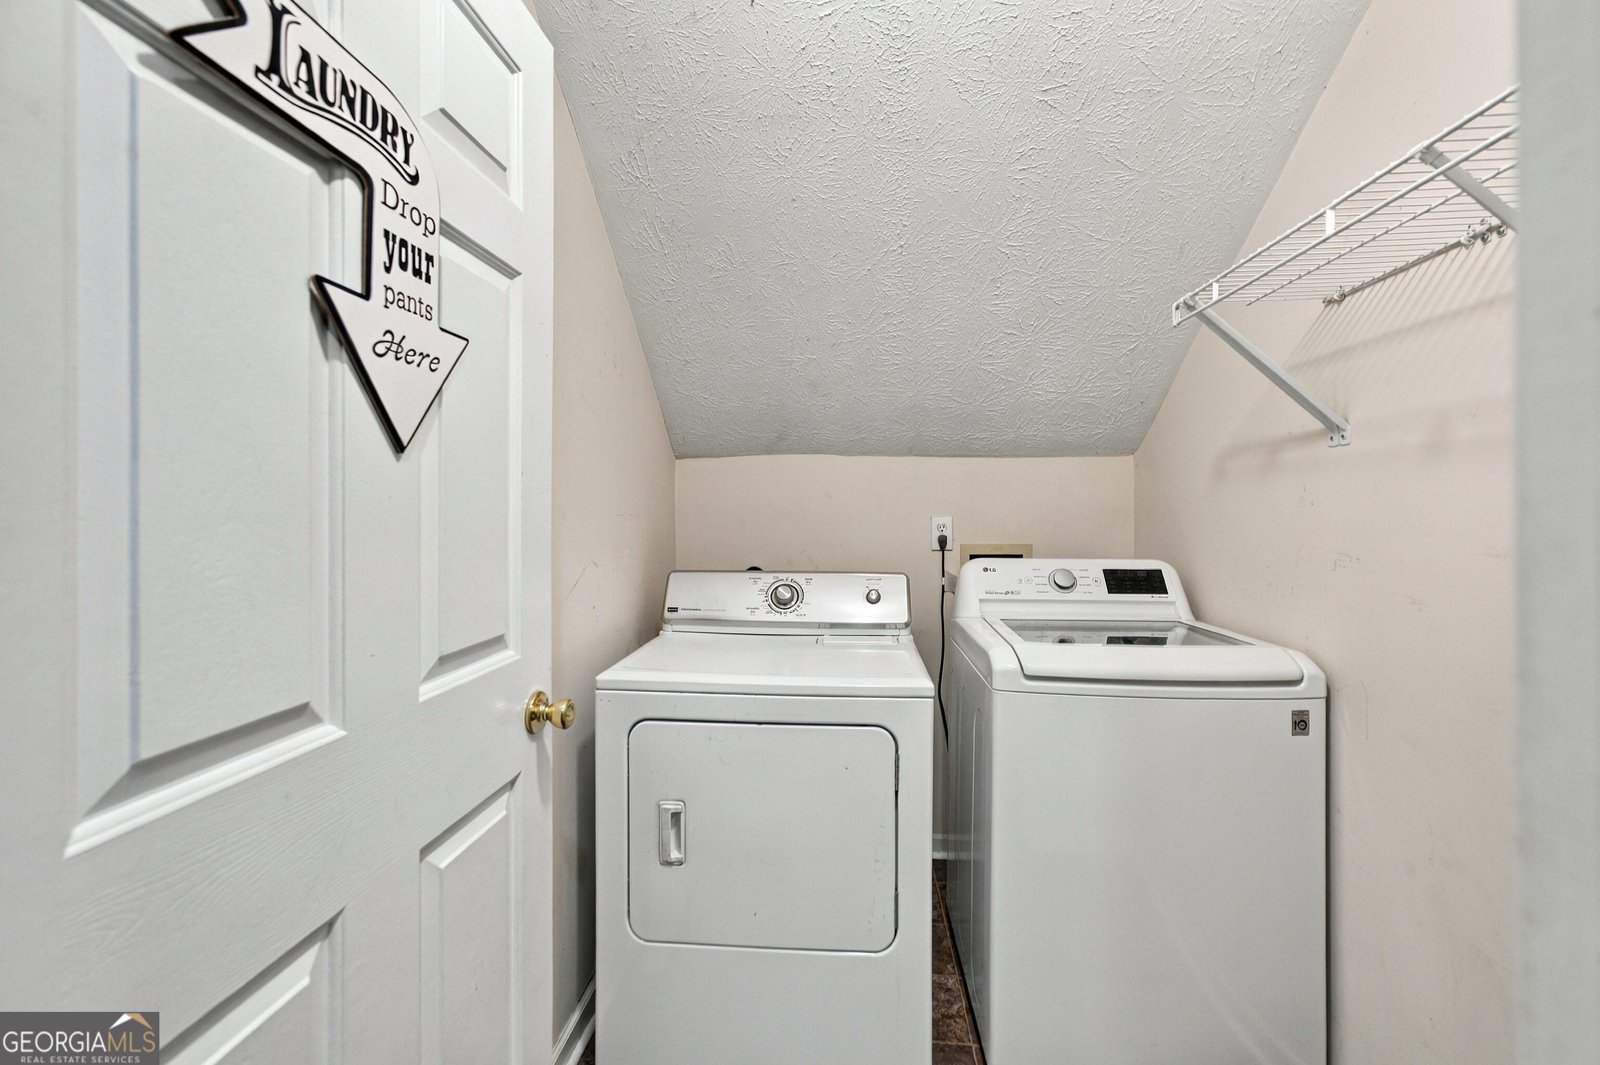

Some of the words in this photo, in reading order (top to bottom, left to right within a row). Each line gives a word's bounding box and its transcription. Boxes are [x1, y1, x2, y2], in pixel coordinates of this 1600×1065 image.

[255, 0, 415, 167] LAUNDRY
[381, 178, 436, 238] Drop
[383, 228, 434, 285] your
[383, 284, 433, 322] pants
[372, 329, 441, 373] Here
